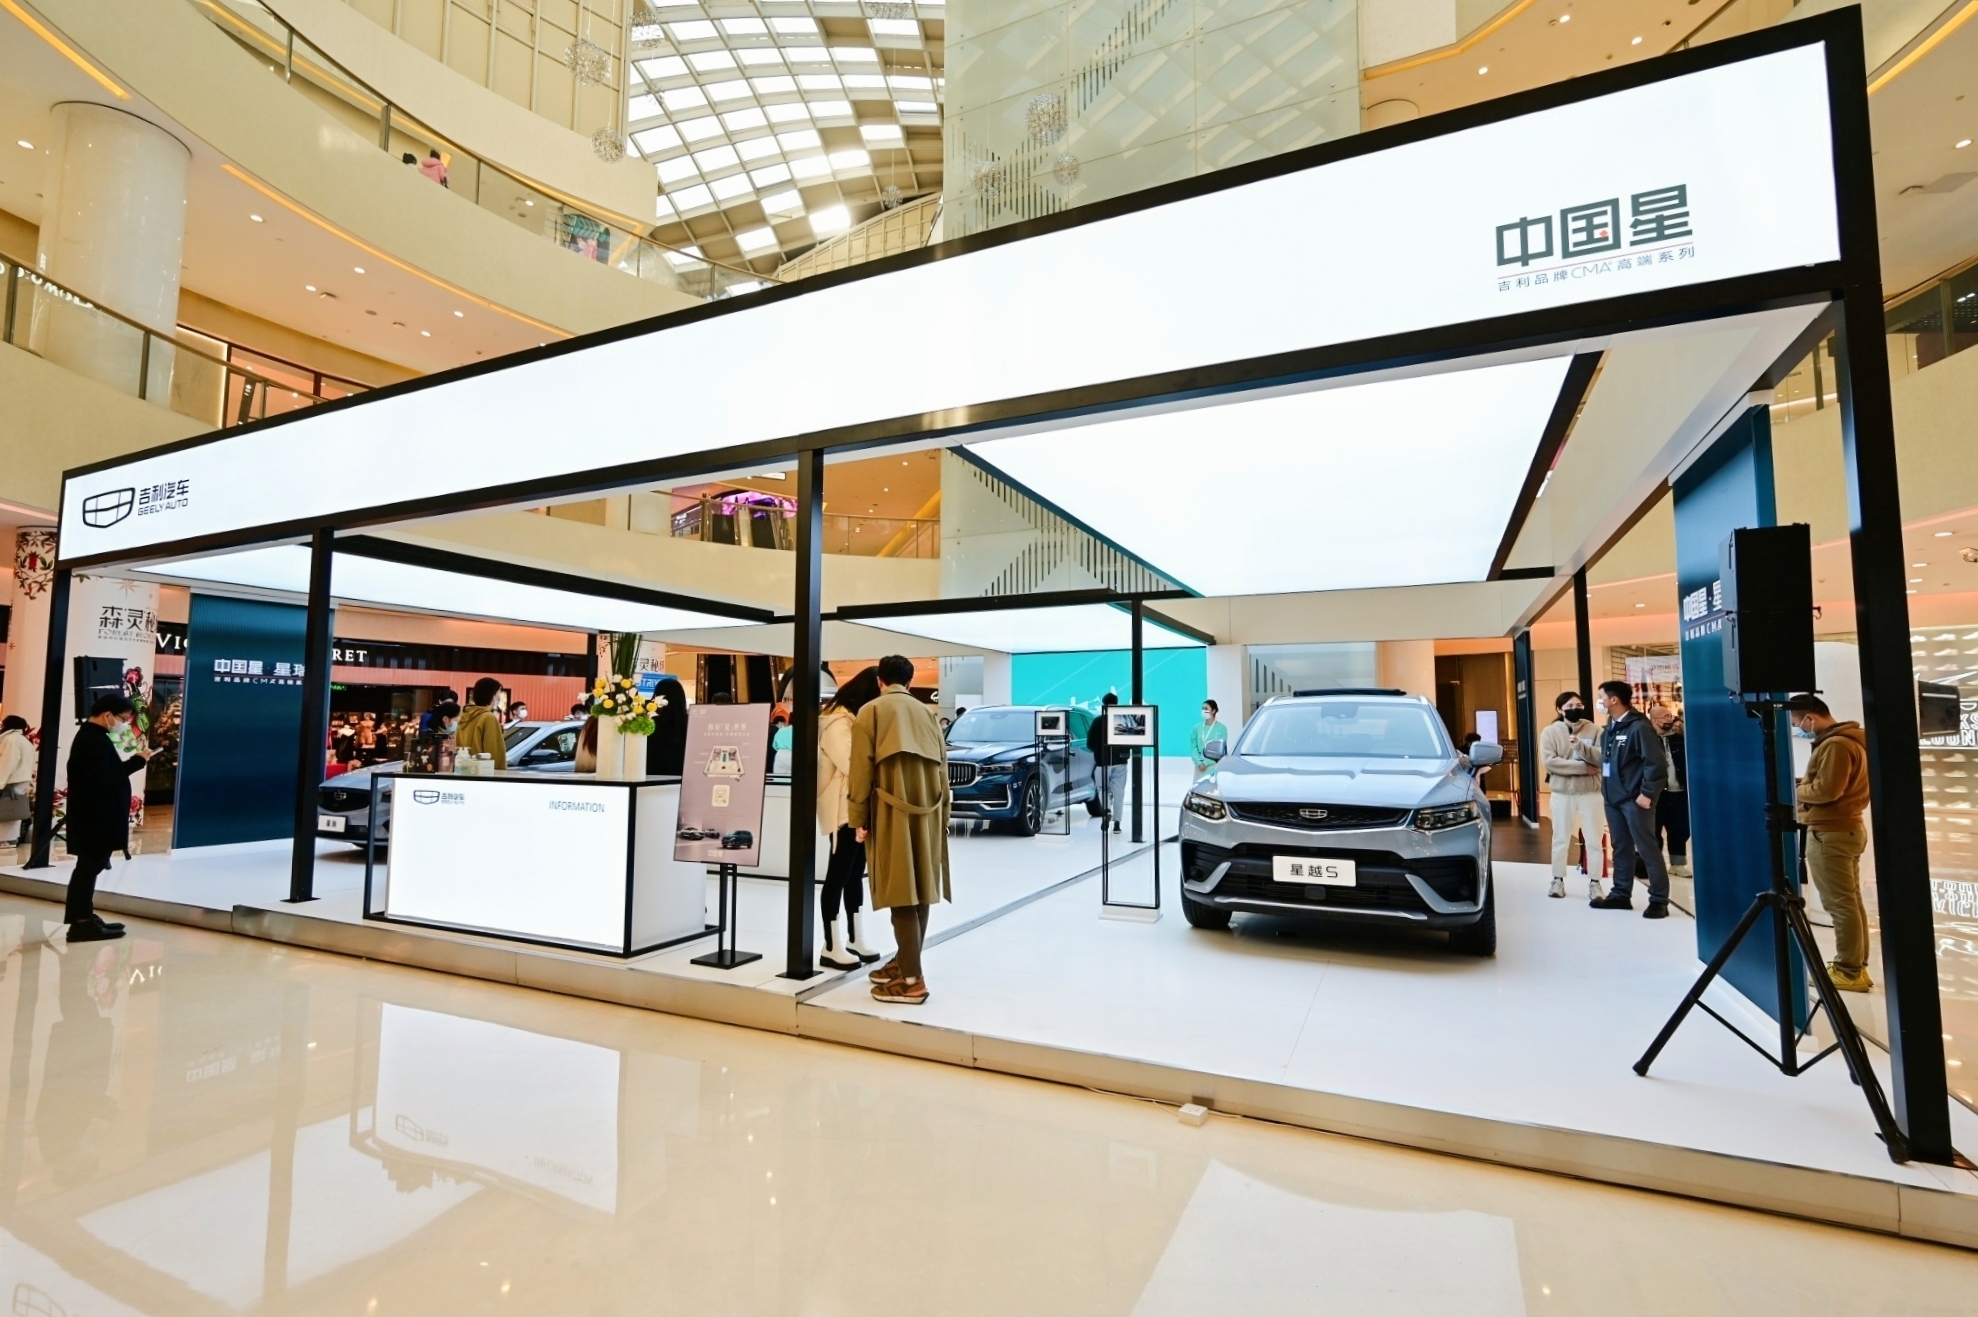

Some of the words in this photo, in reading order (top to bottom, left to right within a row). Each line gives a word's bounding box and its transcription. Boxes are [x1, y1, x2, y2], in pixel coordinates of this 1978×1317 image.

[1496, 183, 1693, 267] 中国星
[139, 479, 189, 505] 吉利汽车
[138, 504, 163, 516] GEELY
[164, 498, 188, 510] AUTO
[549, 800, 605, 812] INFORMATION
[1290, 863, 1339, 878] 星越S
